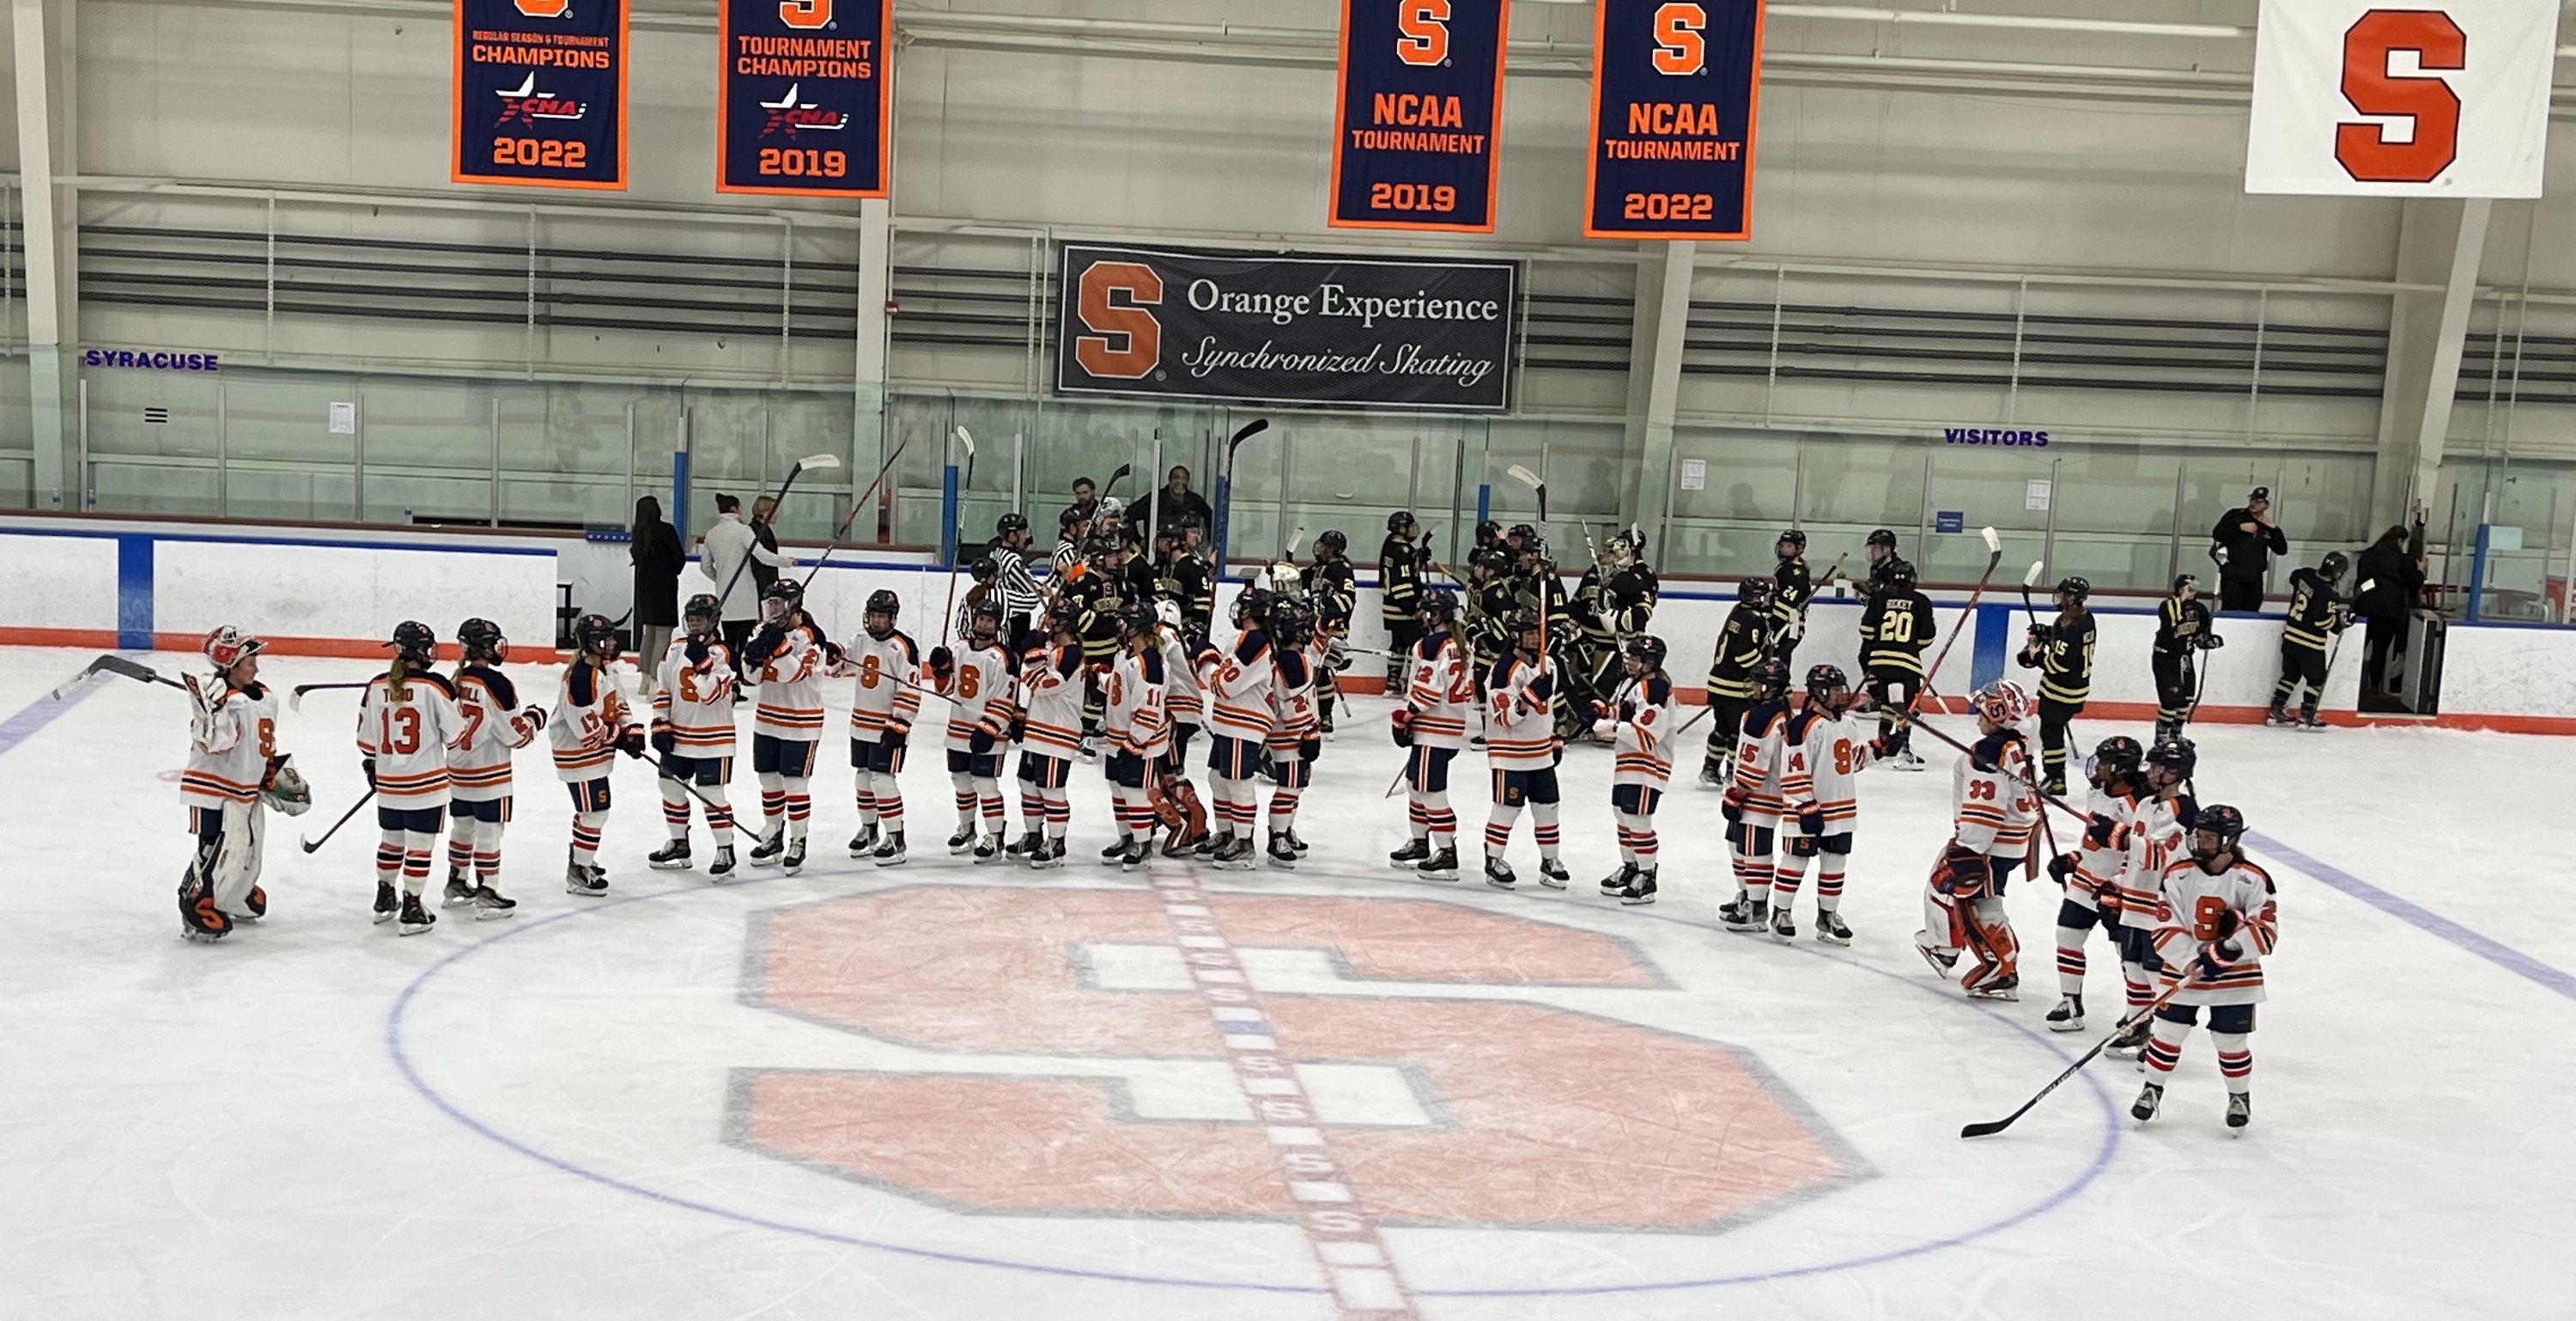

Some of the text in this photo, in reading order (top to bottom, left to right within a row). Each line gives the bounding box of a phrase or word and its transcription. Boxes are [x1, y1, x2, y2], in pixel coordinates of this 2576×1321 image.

[510, 32, 544, 44] SEASON
[552, 33, 610, 48] TOURNAMENT
[738, 35, 872, 59] TOURNAMENT
[1395, 0, 1451, 66] S
[1652, 3, 1706, 76] S
[472, 44, 611, 69] CHAMPIONS
[737, 57, 872, 80] CHAMPIONS
[1374, 92, 1463, 128] NCAA
[2335, 9, 2467, 183] S
[1628, 102, 1719, 136] NCAA
[493, 137, 587, 168] 2022
[1351, 130, 1485, 155] TOURNAMENT
[1605, 139, 1741, 161] TOURNAMENT
[758, 148, 848, 178] 2019
[1370, 183, 1457, 212] 2019
[1623, 193, 1714, 221] 2022
[1187, 278, 1499, 328] Orange Experience
[1076, 260, 1163, 379] S
[86, 349, 219, 371] SYRACUSE
[1182, 336, 1495, 387] Synchronized Skating
[1944, 428, 2050, 447] VISITORS
[1880, 611, 1914, 642] 20
[381, 707, 421, 755] 13
[1970, 779, 1996, 801] 33
